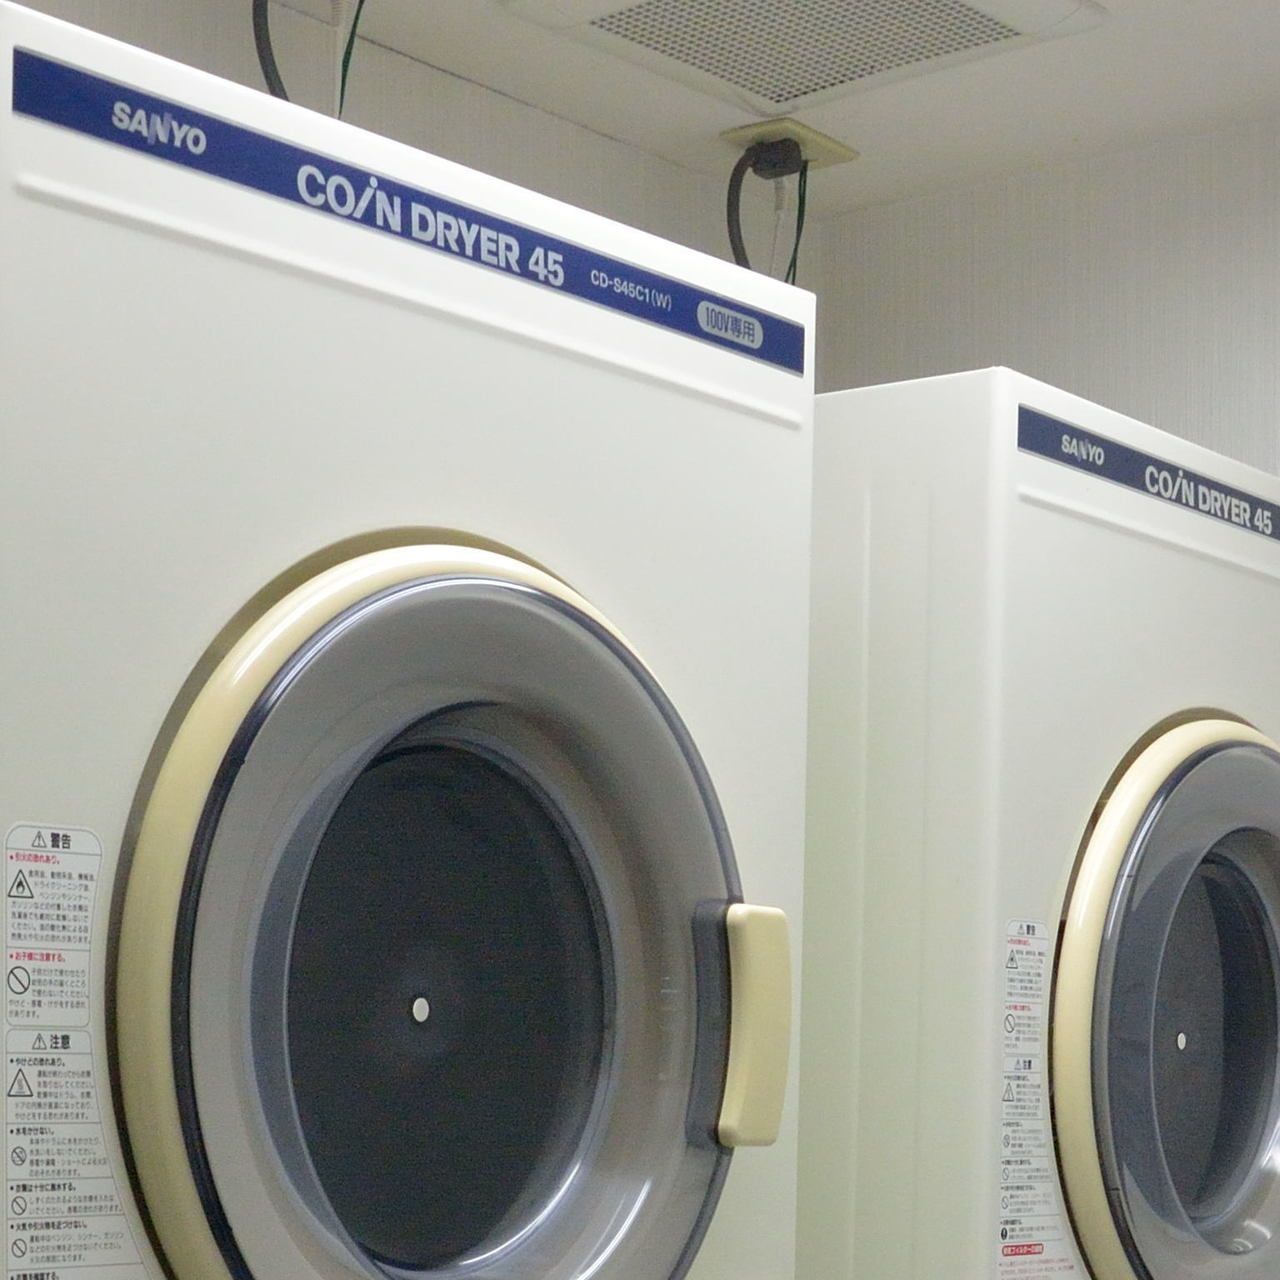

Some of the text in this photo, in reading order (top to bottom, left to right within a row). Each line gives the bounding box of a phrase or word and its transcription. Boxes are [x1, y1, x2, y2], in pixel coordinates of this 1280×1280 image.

[112, 101, 206, 155] SANYO
[411, 205, 521, 273] DRYER
[527, 246, 565, 287] 45
[703, 305, 757, 343] 100V専用
[1061, 434, 1104, 466] SANYO
[1198, 487, 1251, 528] DRYER
[1254, 507, 1273, 536] 45
[51, 832, 72, 849] 警告
[50, 1034, 71, 1050] 注意
